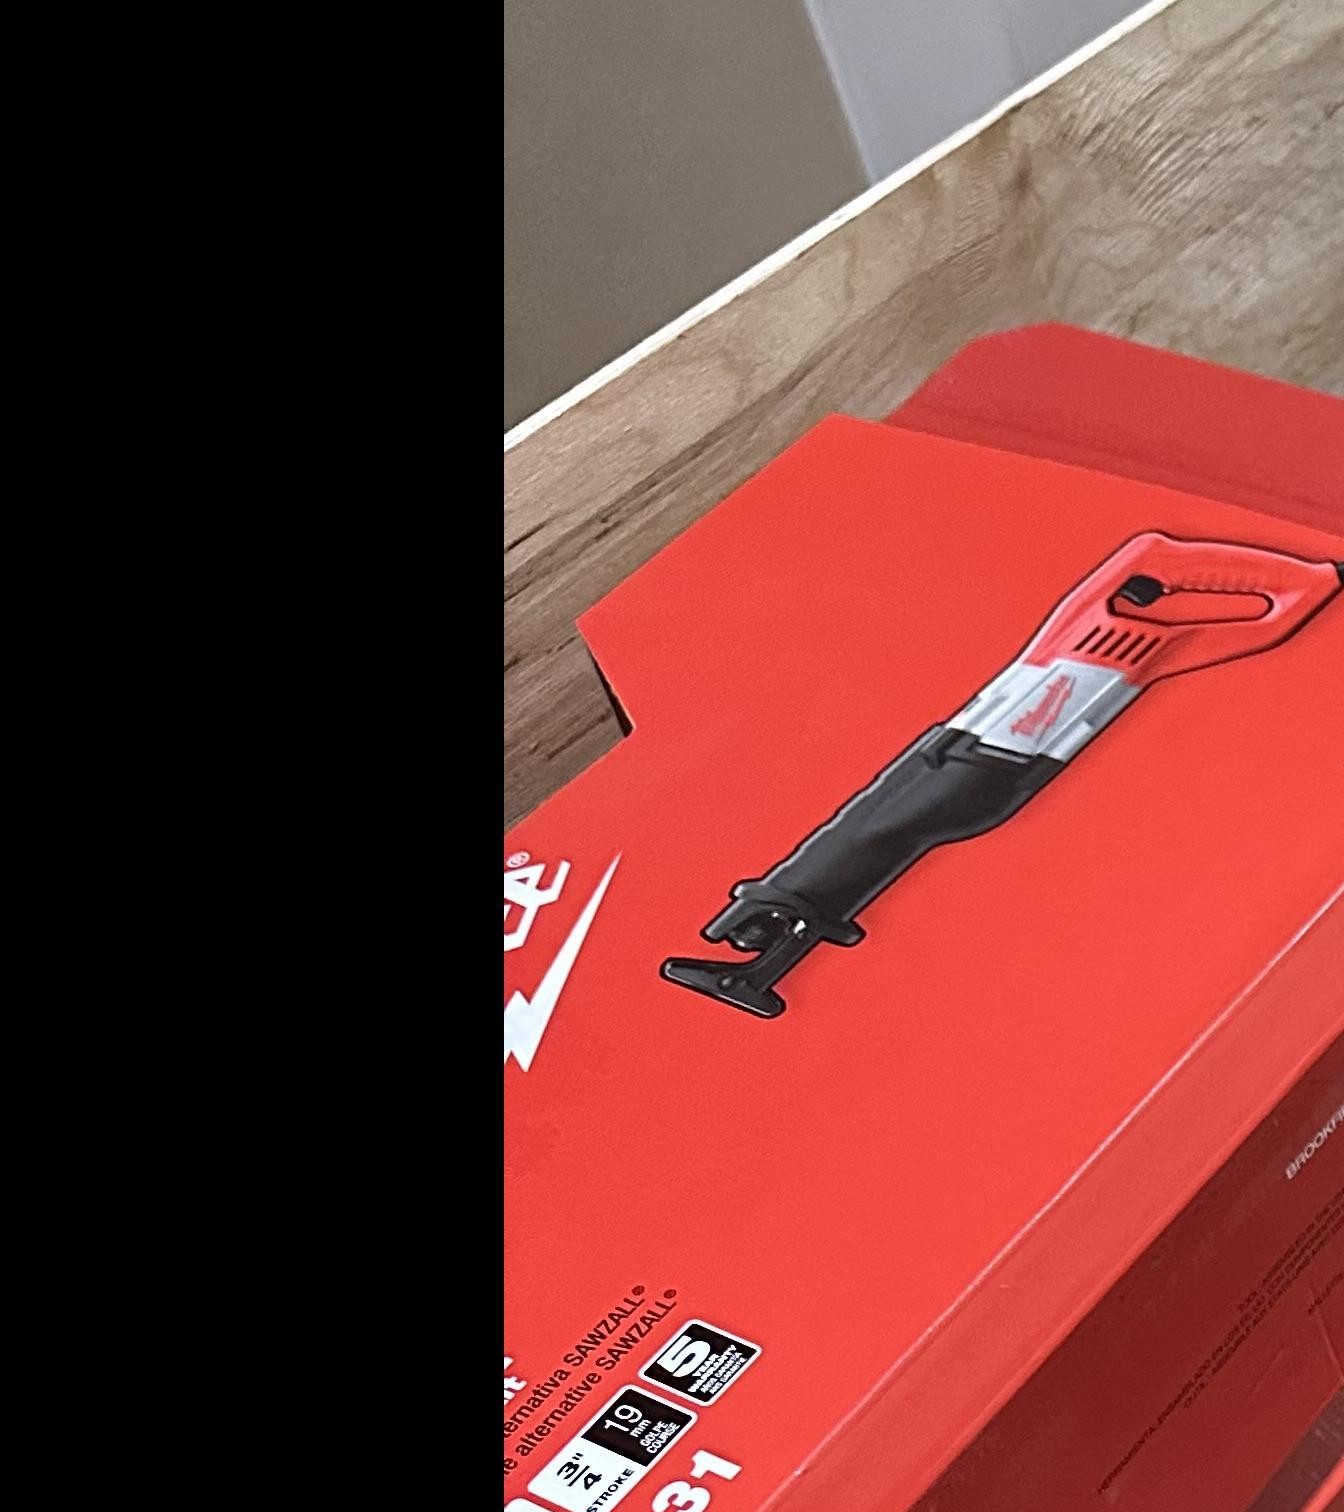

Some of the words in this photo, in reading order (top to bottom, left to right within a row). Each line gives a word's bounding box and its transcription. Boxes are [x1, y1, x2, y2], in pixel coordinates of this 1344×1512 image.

[657, 1335, 710, 1378] 5
[687, 1344, 737, 1393] WARRANTY
[504, 1368, 571, 1439] ternativa
[515, 1371, 602, 1457] alternative
[604, 1403, 643, 1432] 19
[640, 1421, 668, 1447] GOLPE
